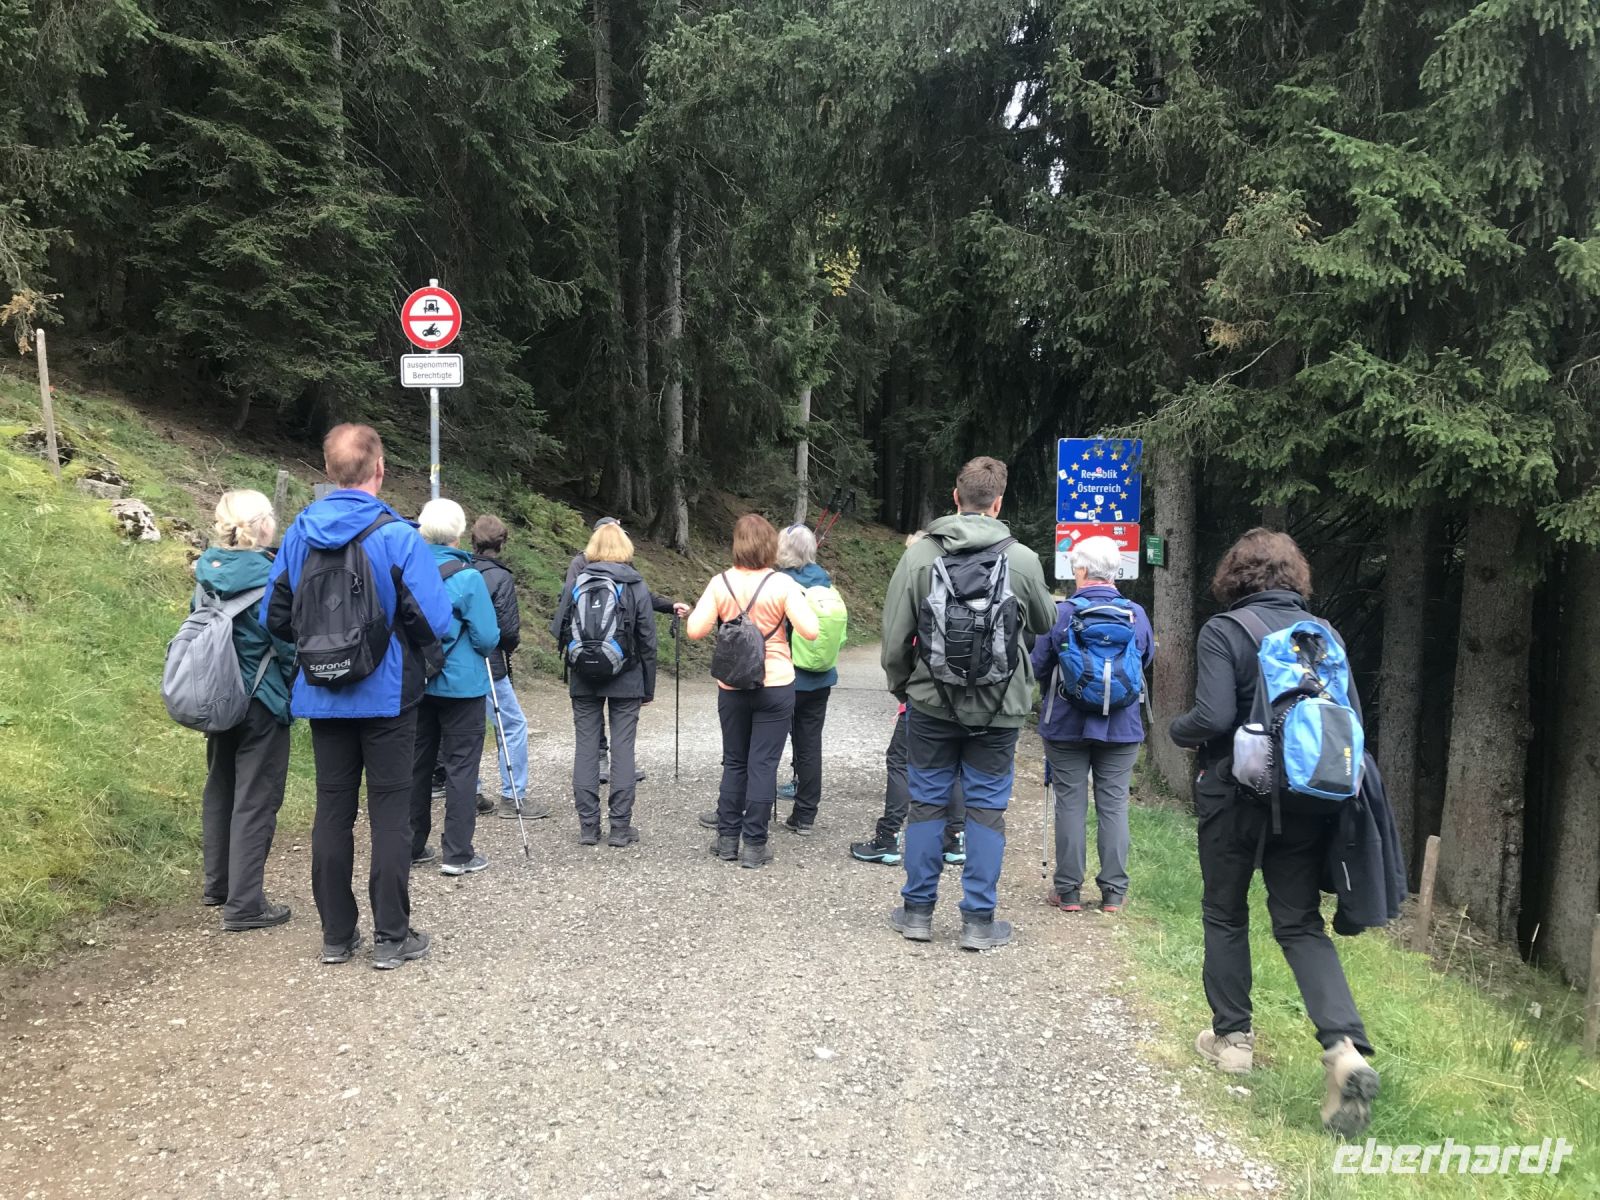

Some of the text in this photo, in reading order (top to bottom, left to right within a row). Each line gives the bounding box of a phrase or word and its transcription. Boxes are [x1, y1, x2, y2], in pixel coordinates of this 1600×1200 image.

[407, 361, 458, 370] ausgenommen
[413, 372, 452, 380] Berechtigte
[1077, 482, 1121, 493] Österreich
[309, 660, 351, 672] sprandi
